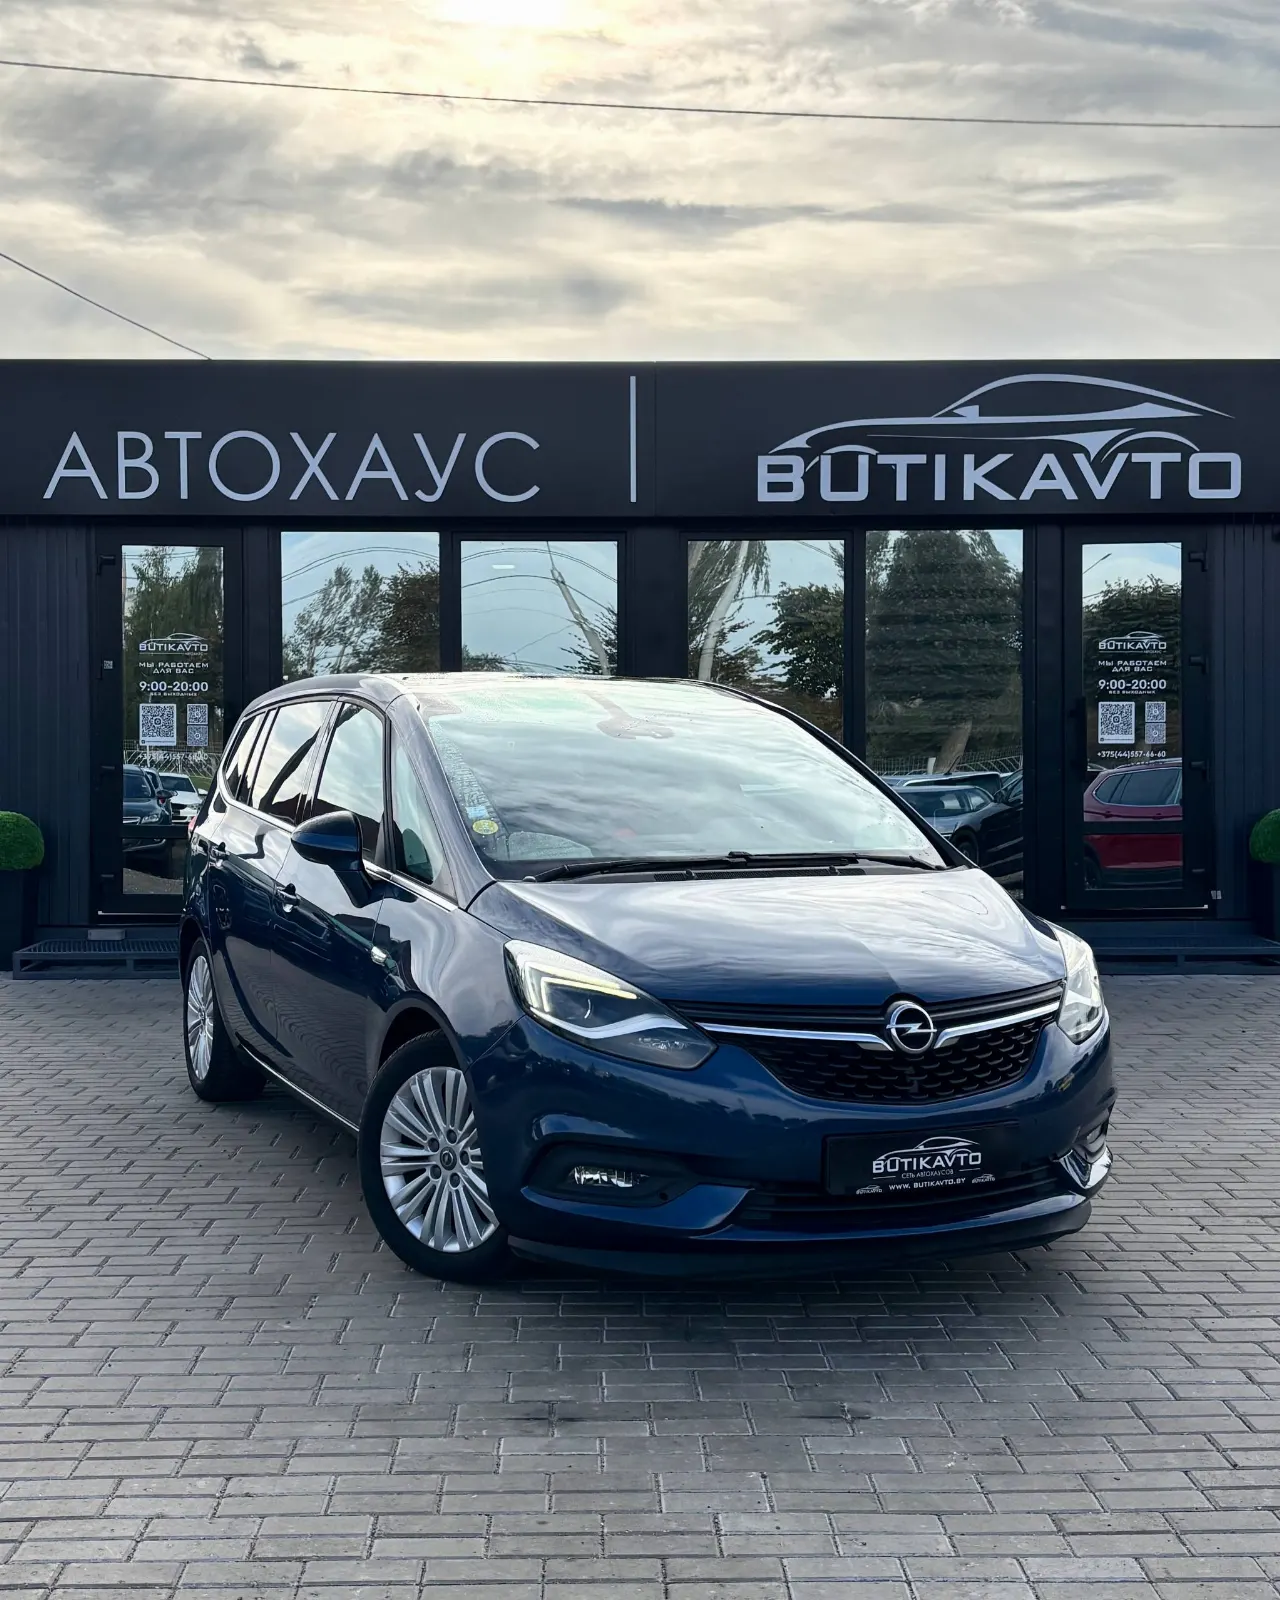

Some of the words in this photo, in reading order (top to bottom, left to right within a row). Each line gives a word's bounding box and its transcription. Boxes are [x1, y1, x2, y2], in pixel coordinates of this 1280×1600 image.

[43, 430, 540, 503] АВТОХАУС
[757, 452, 1242, 502] BUTIKAVTO
[139, 643, 208, 652] BUTIKAVTO
[1099, 641, 1167, 649] BUTIKAVTO
[139, 681, 209, 692] 9:00-20:00
[1098, 679, 1167, 690] 9:00-20:00
[872, 1152, 981, 1173] BUTIKAVTO
